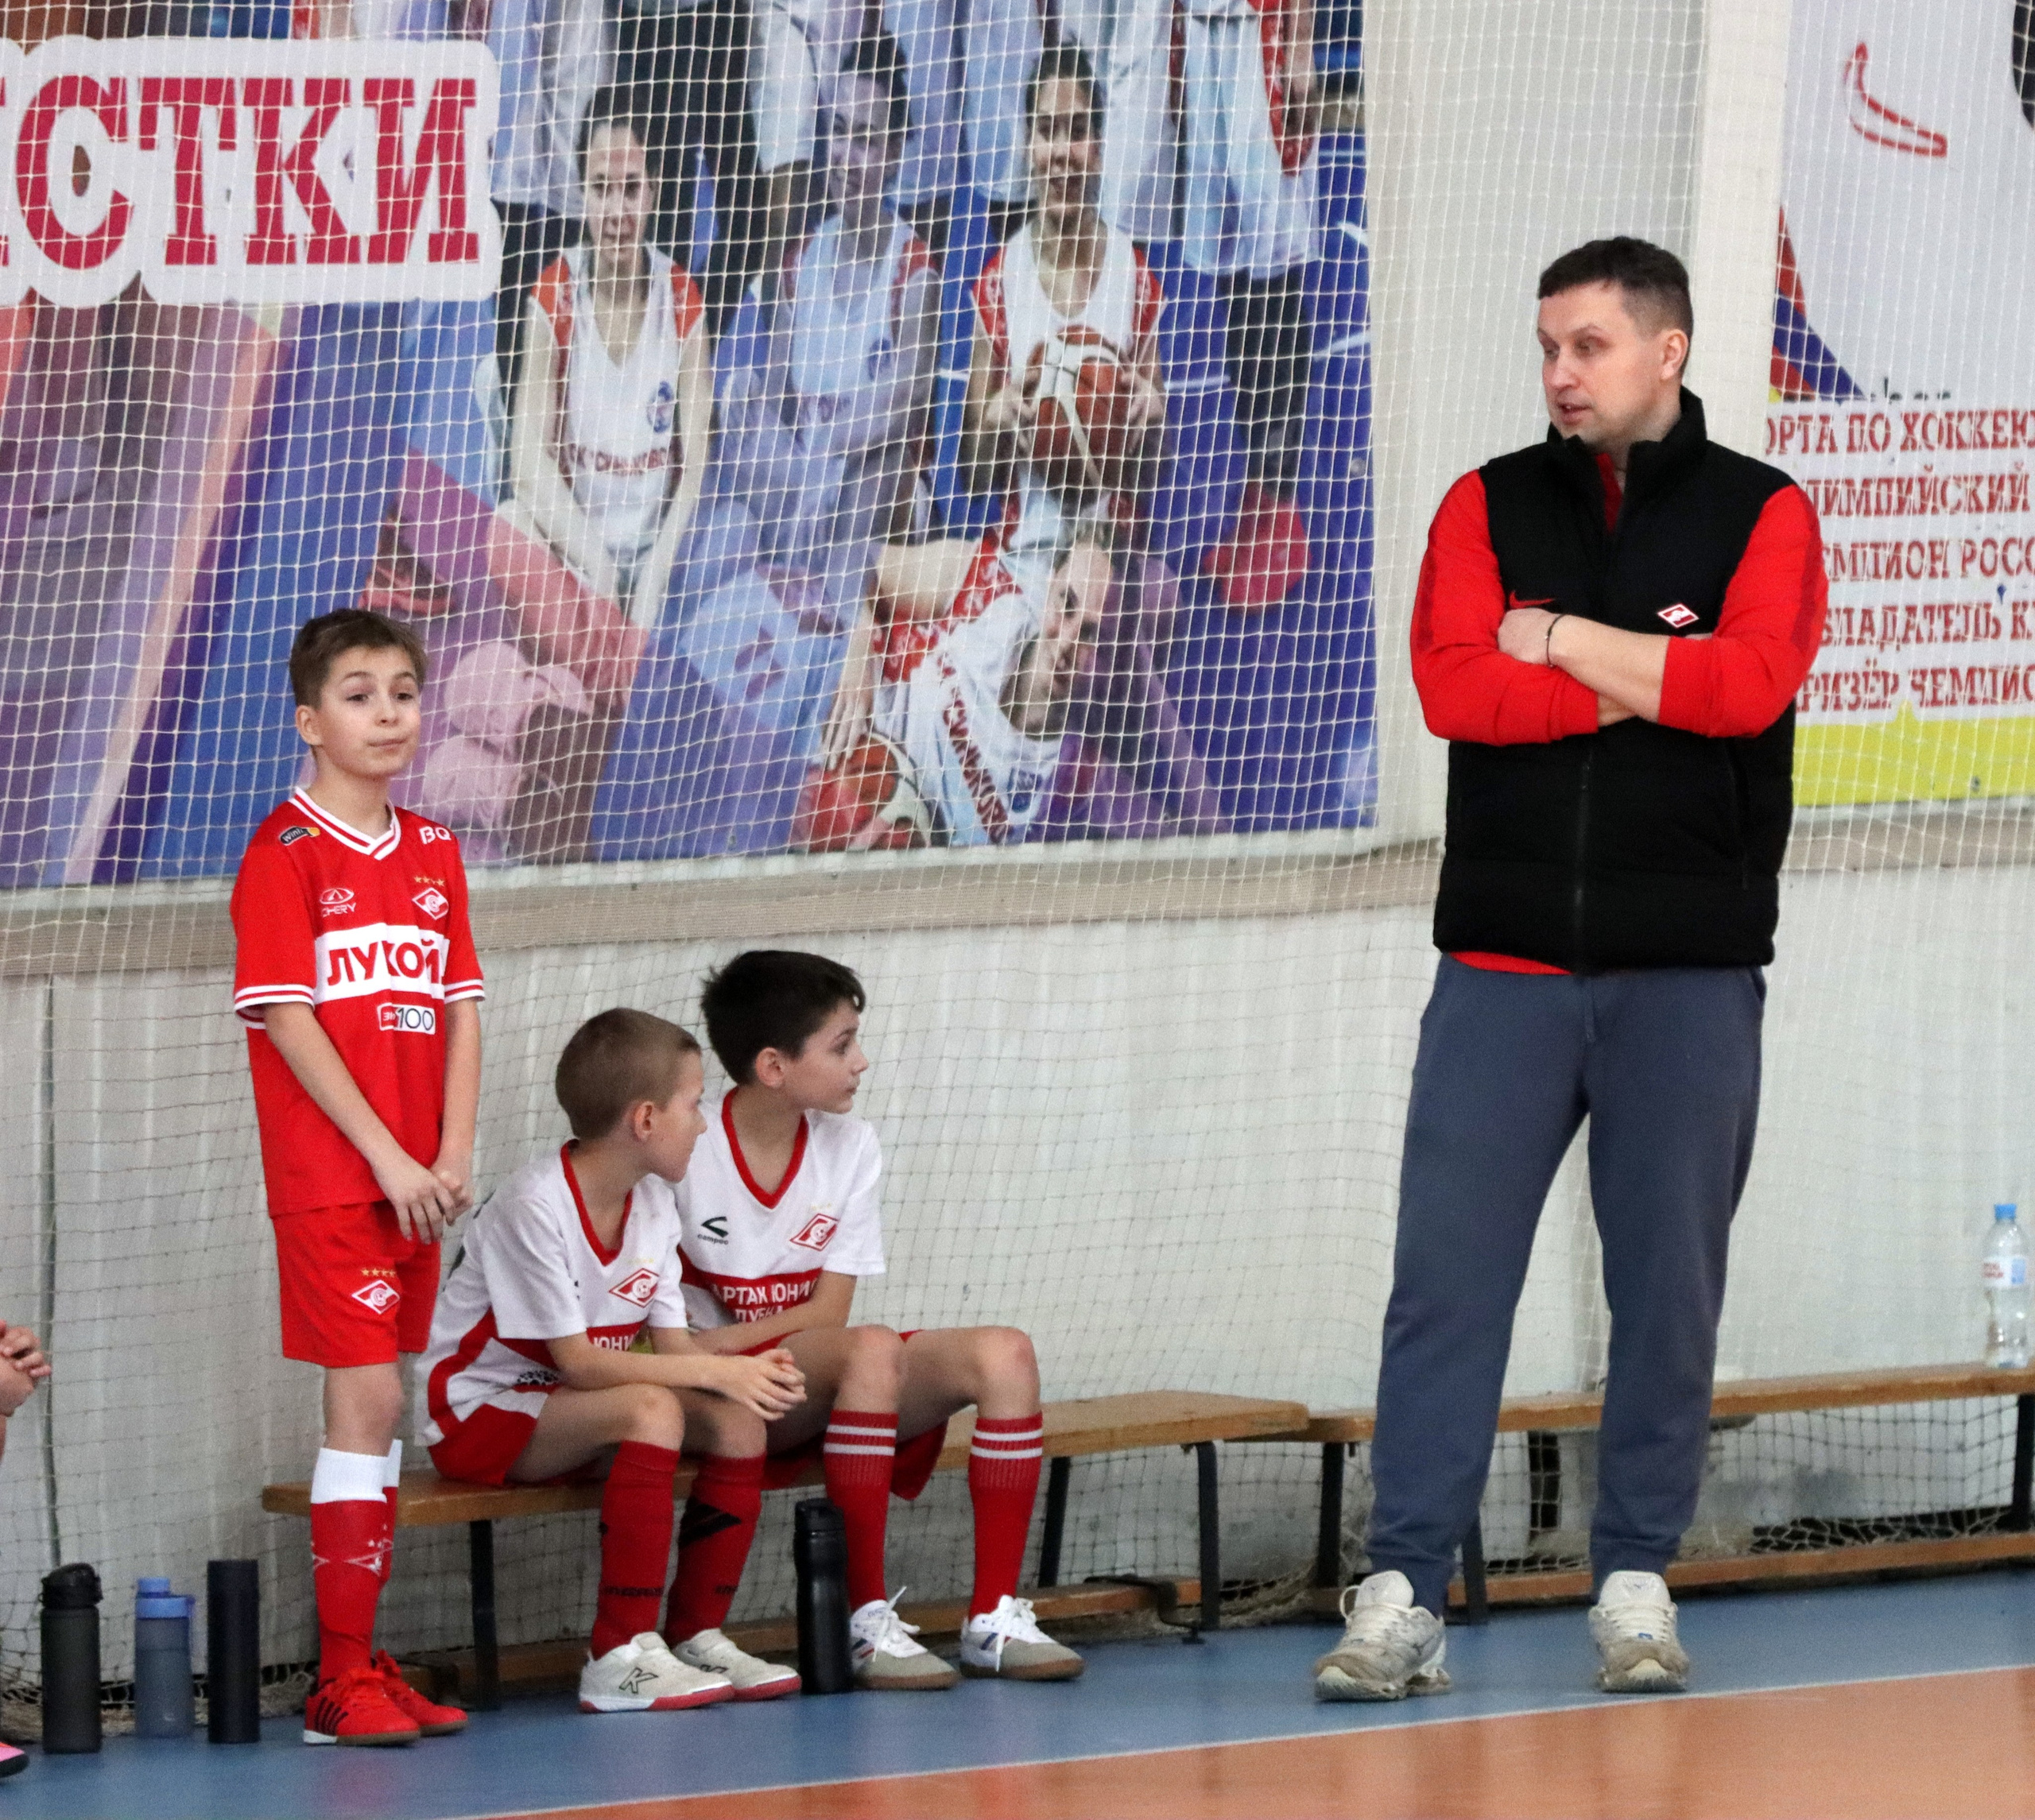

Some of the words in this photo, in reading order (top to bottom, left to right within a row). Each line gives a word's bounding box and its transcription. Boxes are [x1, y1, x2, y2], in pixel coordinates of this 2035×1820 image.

[0, 75, 479, 270] СТКИ
[1847, 412, 1891, 453] ПО
[2010, 600, 2035, 641] К
[1797, 658, 1899, 713] РИЗЁР
[418, 826, 452, 845] BQ
[397, 1007, 434, 1031] 100
